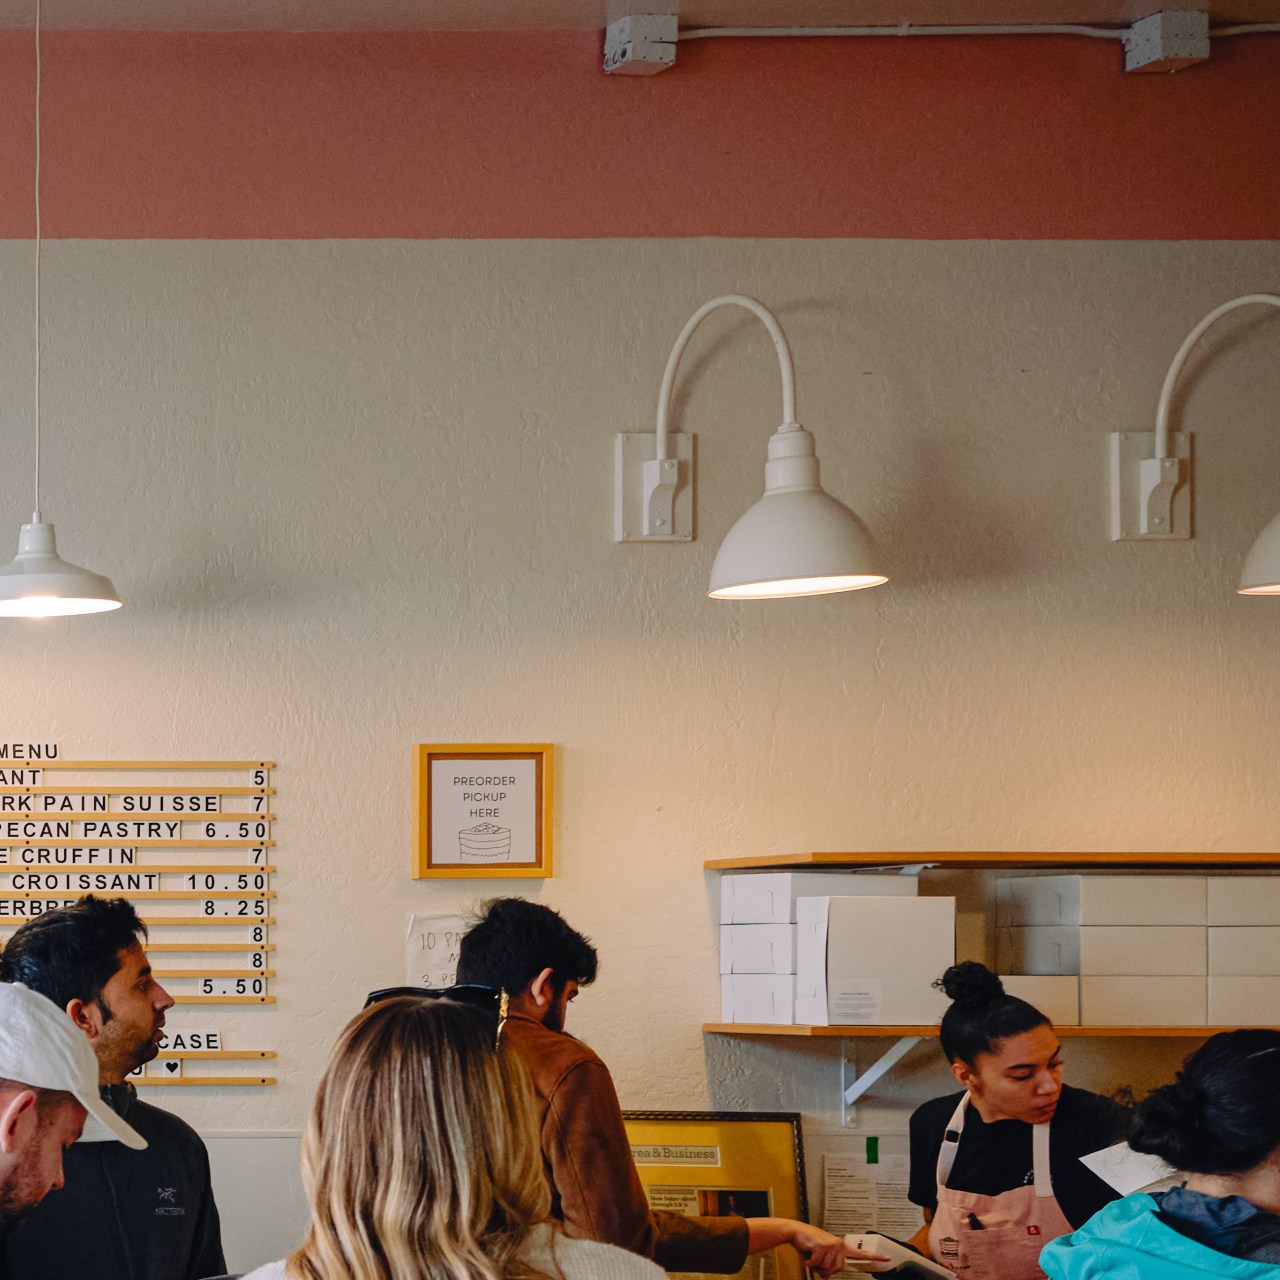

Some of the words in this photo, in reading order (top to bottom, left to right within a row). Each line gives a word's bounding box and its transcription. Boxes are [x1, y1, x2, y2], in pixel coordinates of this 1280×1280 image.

[254, 770, 265, 786] 5
[453, 776, 516, 786] PREORDER
[44, 795, 106, 812] PAIN
[123, 796, 218, 812] SUISSE
[253, 796, 264, 812] 7
[463, 792, 507, 802] PICKUP
[469, 808, 500, 818] HERE
[84, 822, 179, 838] PASTRY
[205, 822, 266, 838] 6.50
[21, 848, 133, 864] CRUFFIN
[252, 848, 263, 864] 7
[12, 874, 157, 890] CROISSANT
[188, 874, 265, 890] 10.50
[204, 899, 265, 916] 8.25
[252, 926, 263, 943] 8
[252, 952, 263, 969] 8
[202, 979, 264, 995] 5.50
[157, 1033, 219, 1049] CASE
[631, 1150, 651, 1158] rea
[651, 1148, 662, 1159] &
[663, 1147, 716, 1159] Business
